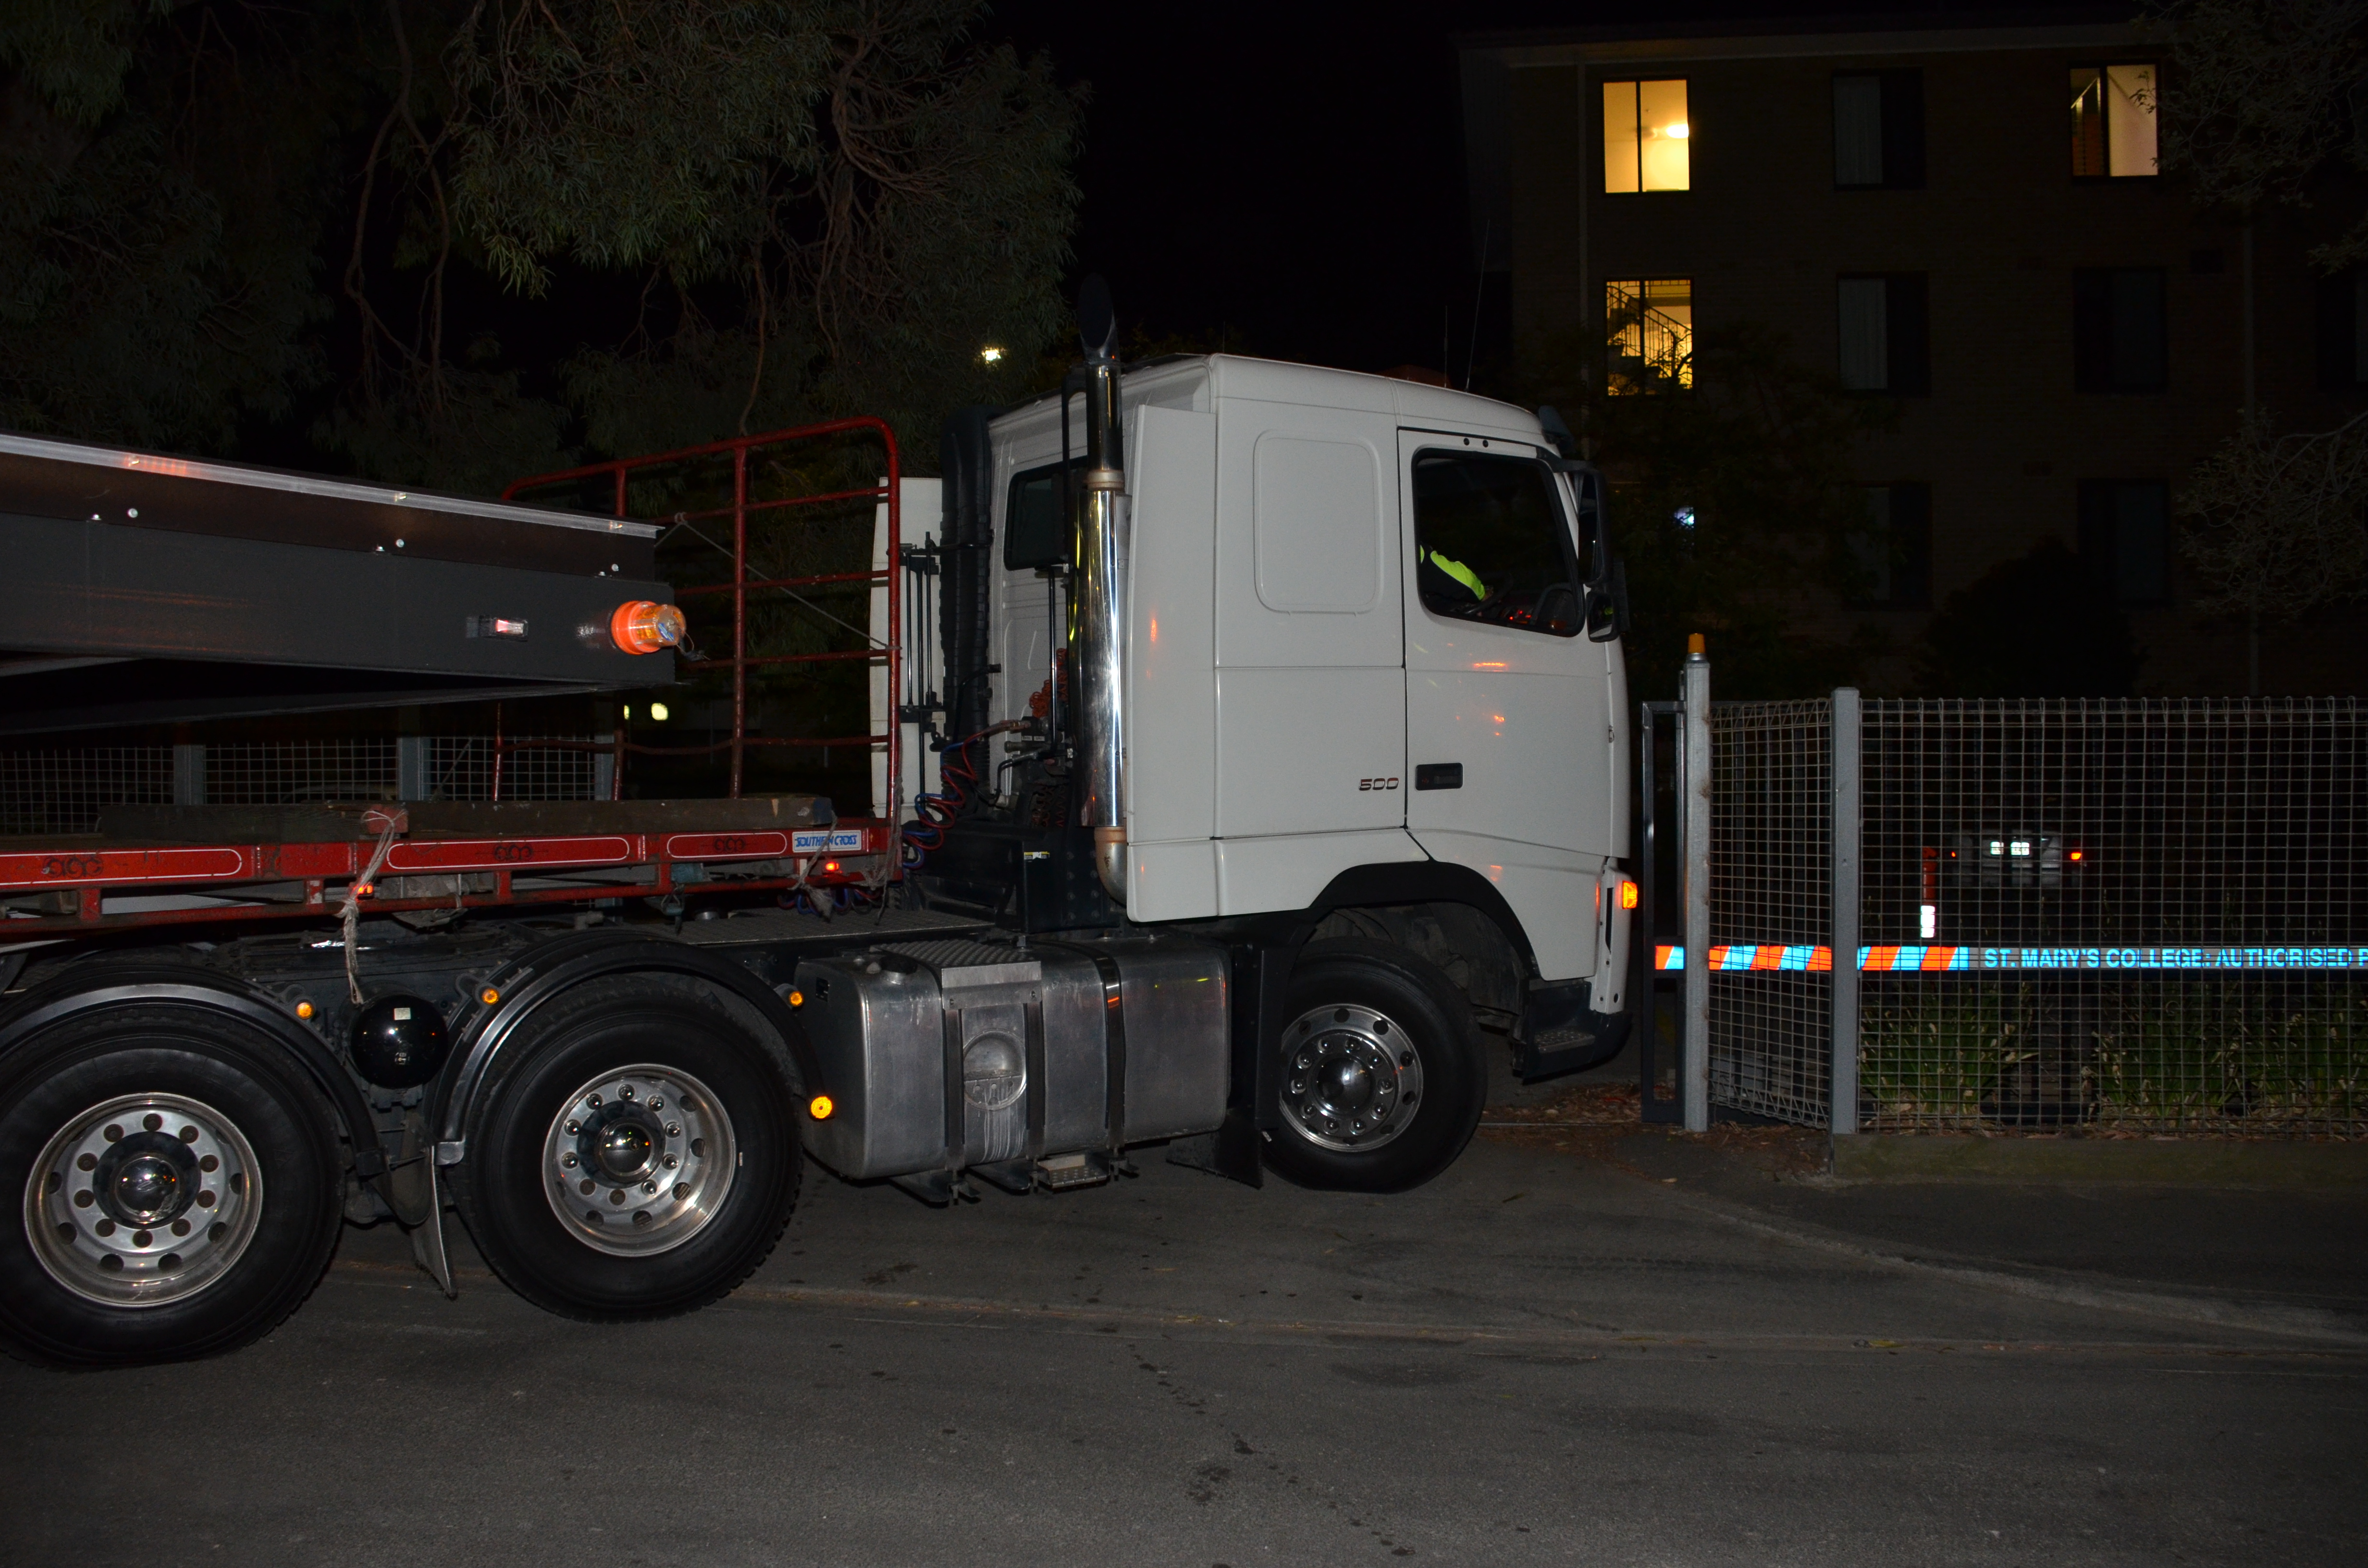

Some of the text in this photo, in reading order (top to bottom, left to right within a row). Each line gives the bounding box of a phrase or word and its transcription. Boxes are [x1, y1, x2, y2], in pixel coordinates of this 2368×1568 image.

[1358, 777, 1399, 791] 500
[835, 835, 857, 845] CROSS
[1985, 949, 2016, 968] ST.
[2021, 949, 2100, 968] MARY'S
[2106, 949, 2210, 968] COLLEGE:
[2215, 948, 2353, 967] AUTHORISED
